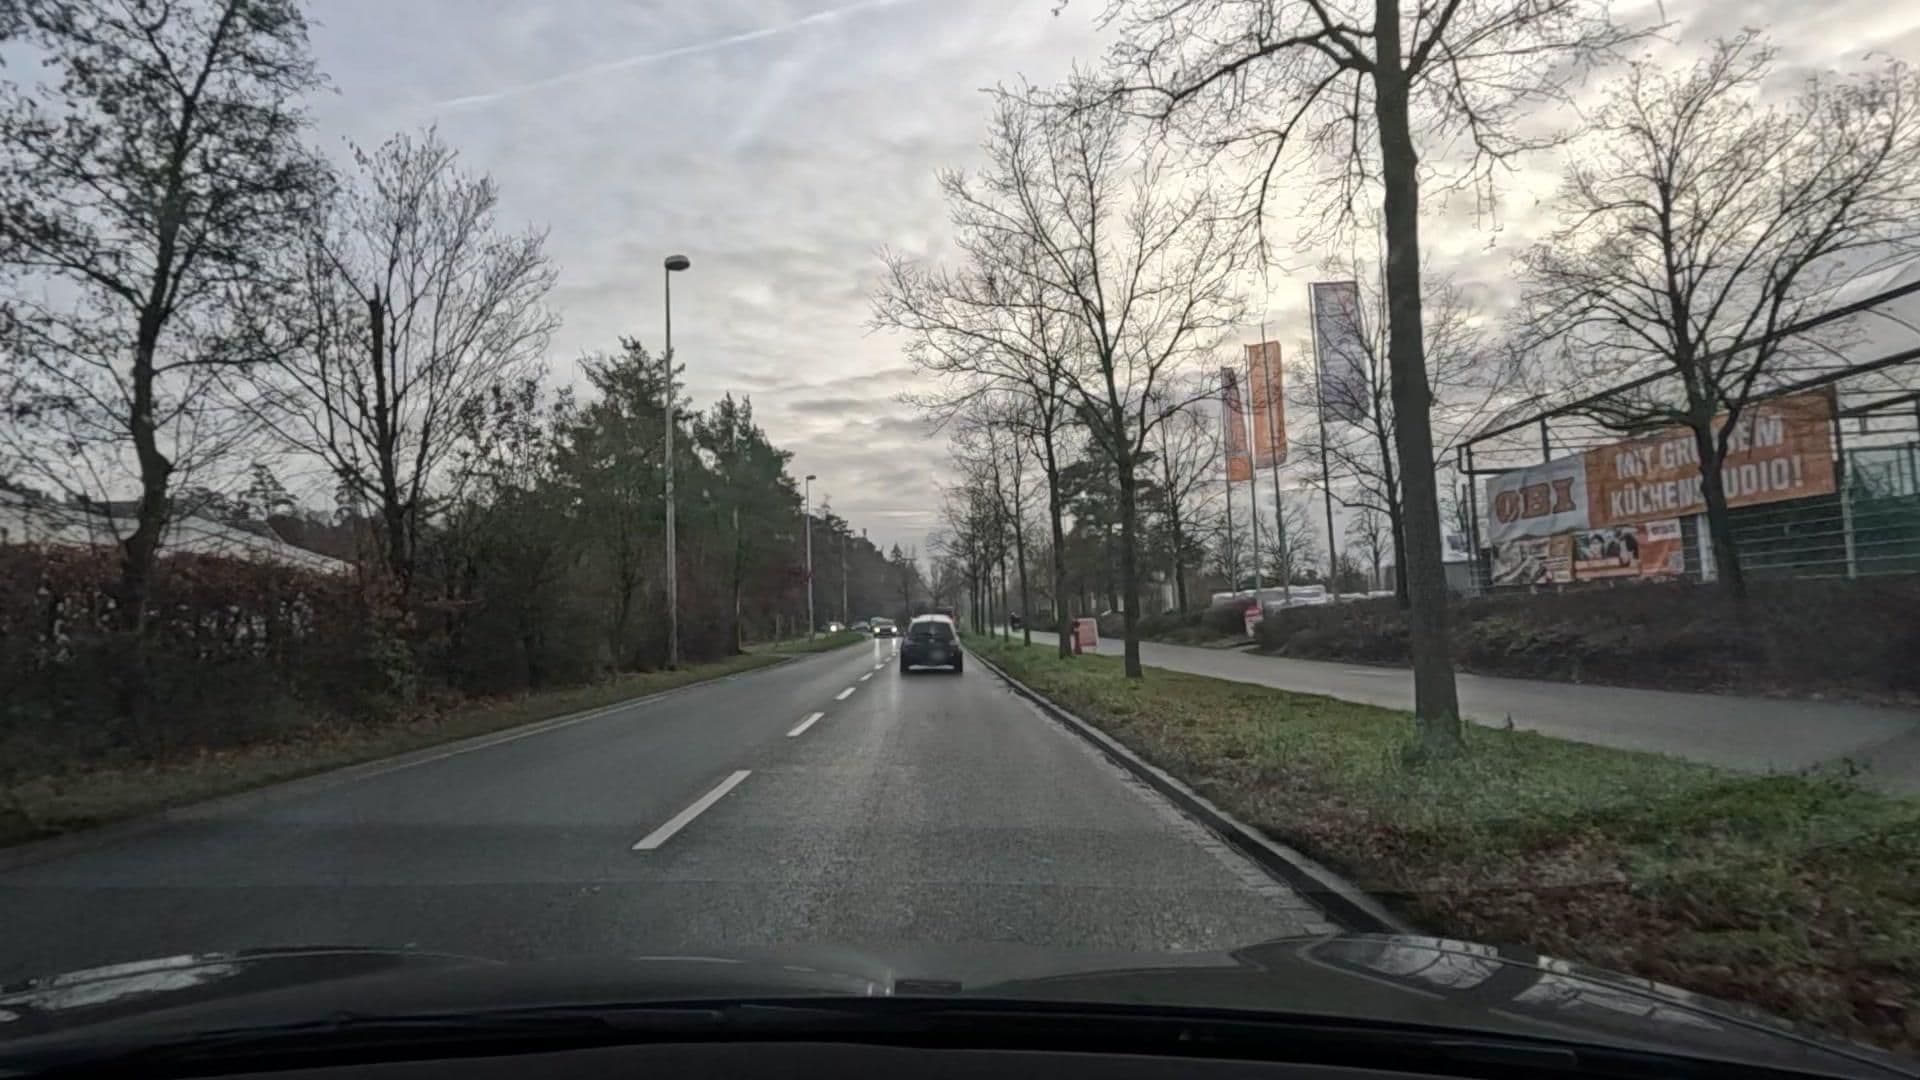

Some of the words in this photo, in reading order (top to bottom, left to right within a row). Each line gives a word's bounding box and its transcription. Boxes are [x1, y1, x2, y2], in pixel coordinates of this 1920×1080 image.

[1610, 454, 1804, 517] KÜCHENSUDIO!
[1615, 446, 1654, 480] MIT
[1495, 477, 1576, 524] OBI
